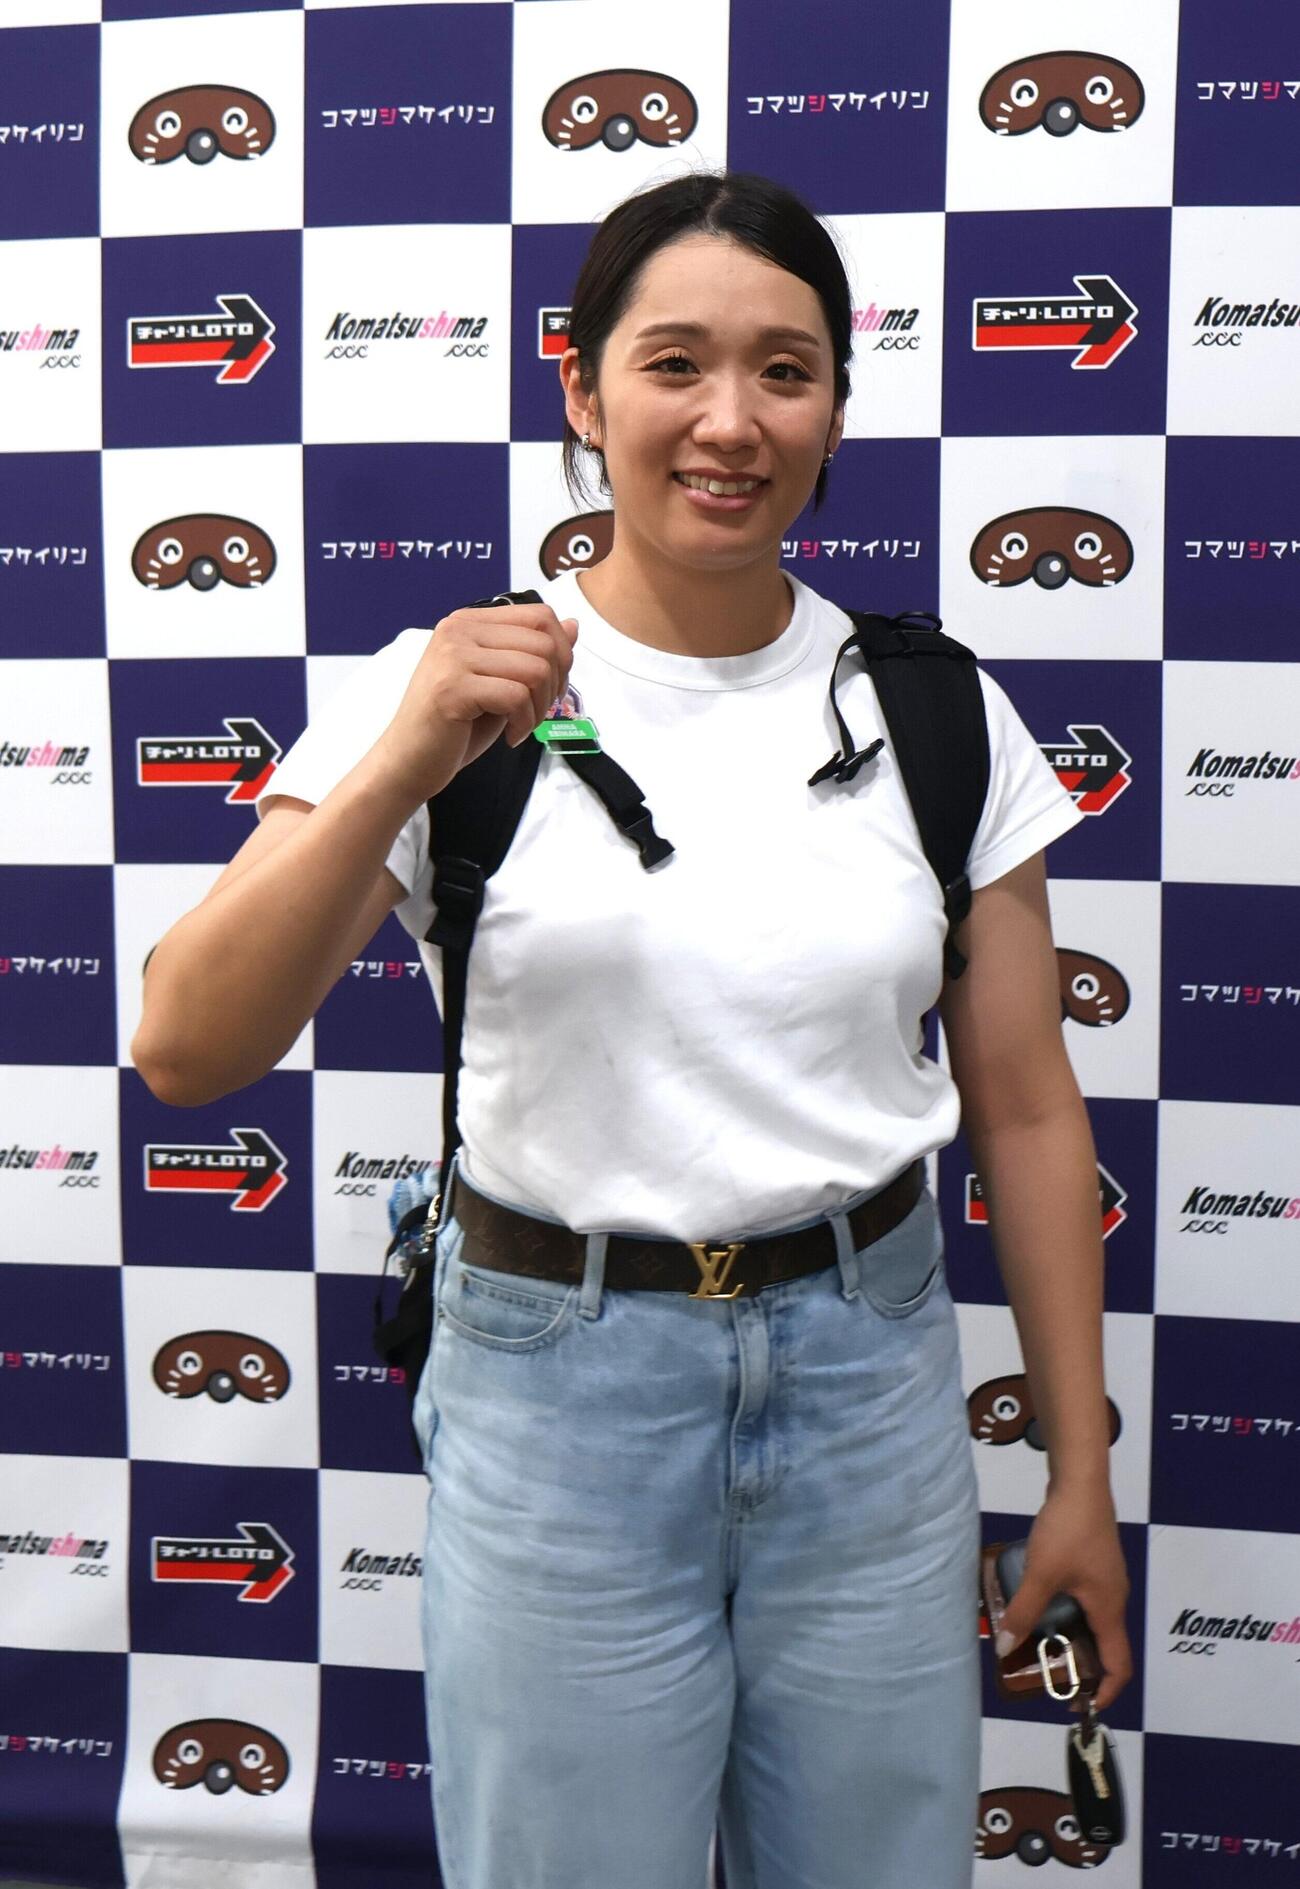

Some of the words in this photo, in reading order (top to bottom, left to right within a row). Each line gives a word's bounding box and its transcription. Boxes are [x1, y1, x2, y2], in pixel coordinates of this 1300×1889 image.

[747, 91, 929, 114] コマツシマケイリン
[322, 105, 494, 127] コマツシマケイリン
[1194, 297, 1300, 327] Komatsu
[325, 312, 488, 341] Komatsushima
[322, 540, 492, 559] コマツシマケイリン
[1049, 753, 1108, 767] OTO
[1181, 1187, 1300, 1218] Komatsus
[0, 1352, 109, 1370] シマケイリン
[1171, 1414, 1300, 1435] コマツシマケ
[342, 1548, 423, 1577] Komats
